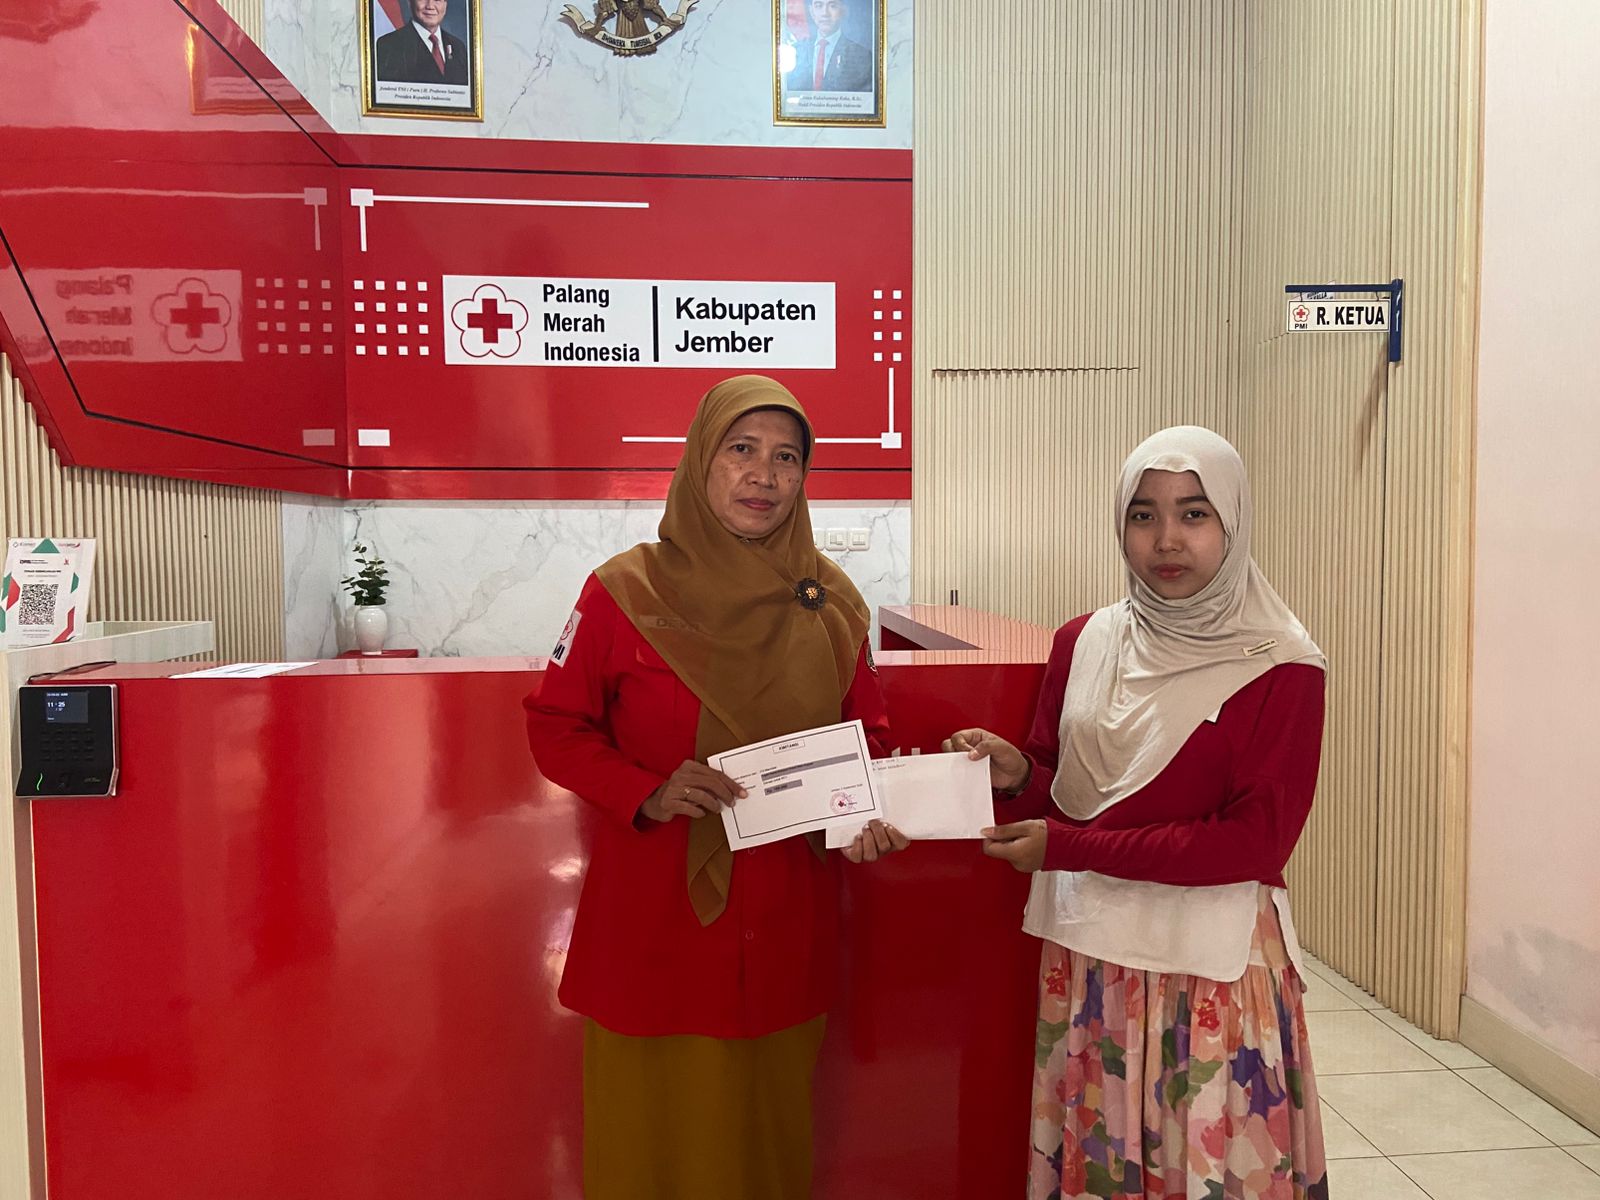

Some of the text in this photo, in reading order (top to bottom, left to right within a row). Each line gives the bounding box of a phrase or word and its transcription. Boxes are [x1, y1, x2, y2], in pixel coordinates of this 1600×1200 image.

[543, 284, 610, 307] Palang
[675, 296, 816, 325] Kabupaten
[1316, 306, 1385, 325] R. KETUA
[544, 312, 606, 333] Merah
[544, 342, 640, 362] Indonesia
[675, 329, 774, 353] Jember
